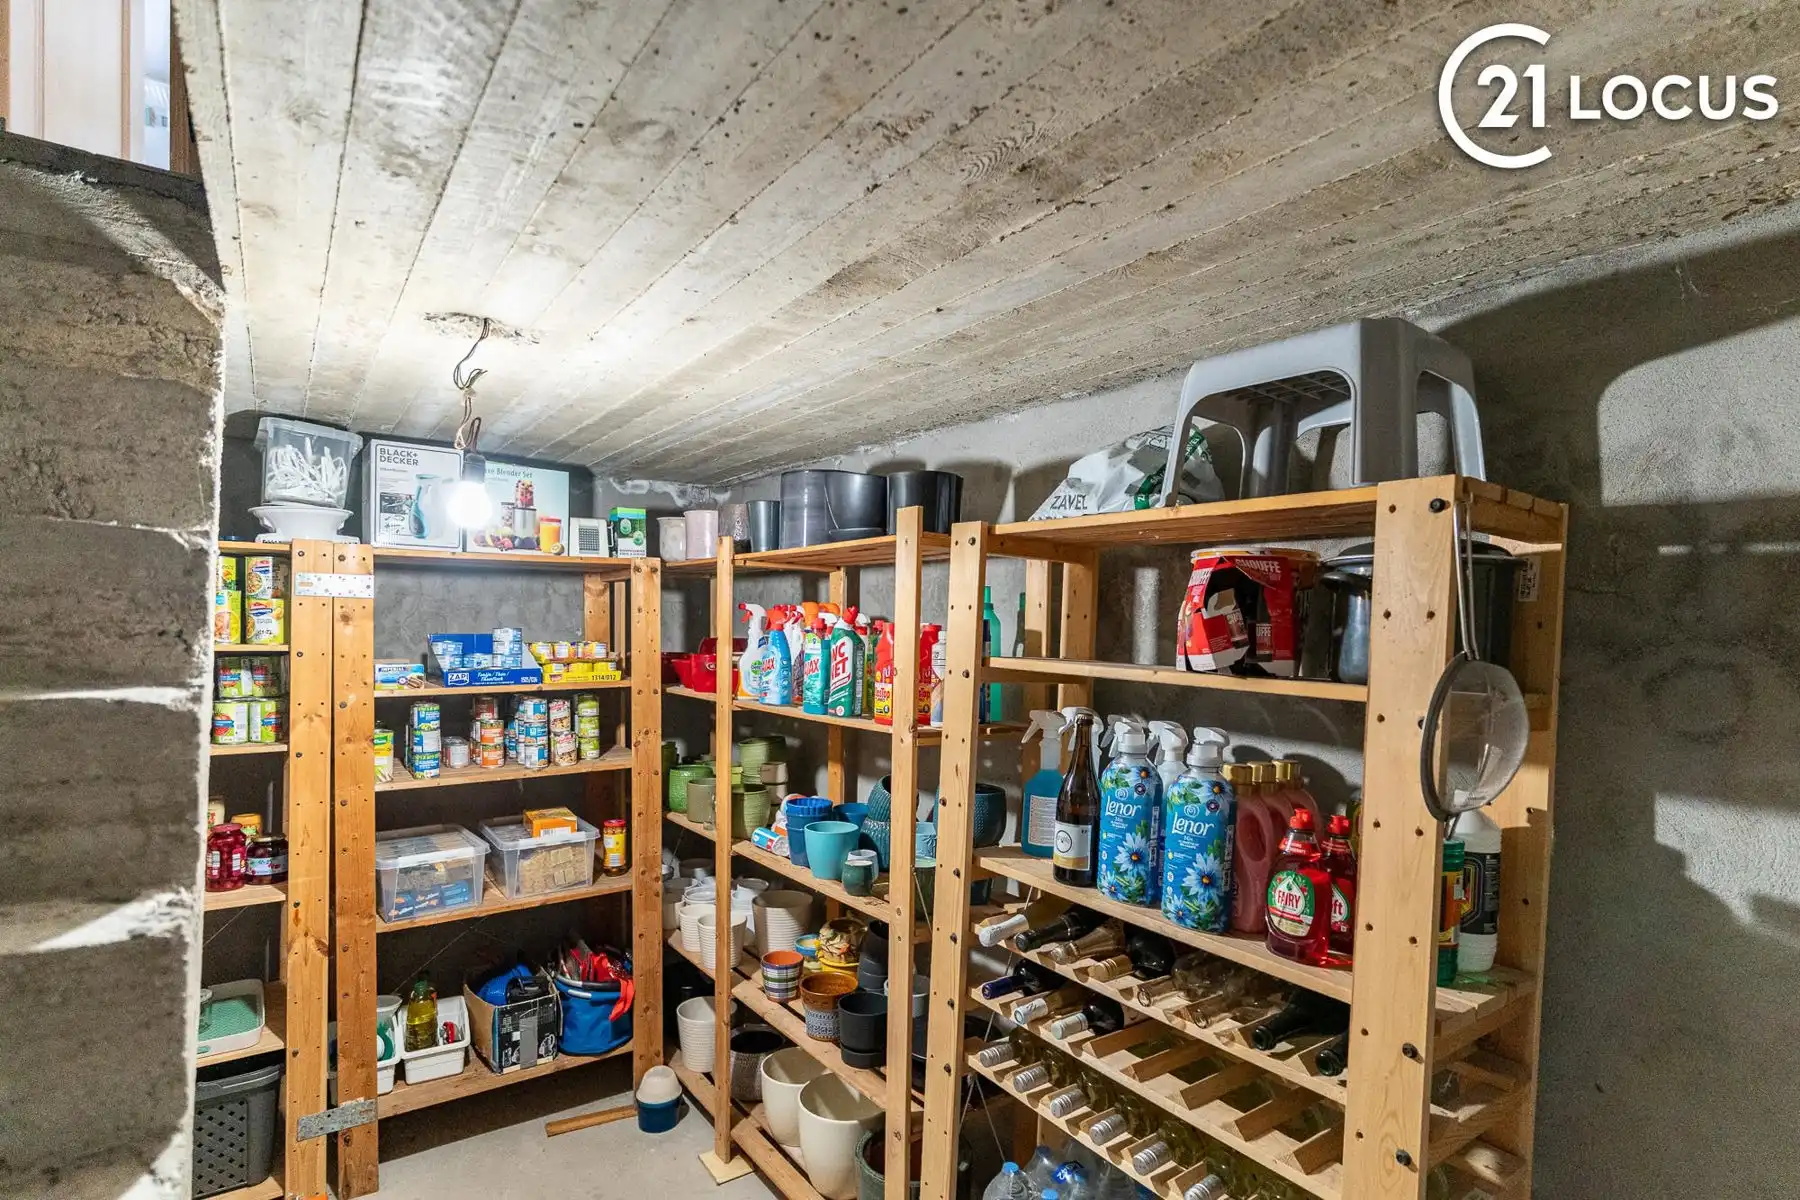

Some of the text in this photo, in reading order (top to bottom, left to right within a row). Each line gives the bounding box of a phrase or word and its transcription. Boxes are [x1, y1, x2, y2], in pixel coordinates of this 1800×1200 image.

[379, 455, 419, 467] DECKER
[496, 467, 521, 478] Blender
[522, 470, 533, 479] Set
[1050, 493, 1088, 511] ZAVEL
[1104, 795, 1142, 817] Lenor
[1172, 812, 1214, 836] Lenor
[1277, 890, 1301, 909] FAIRY
